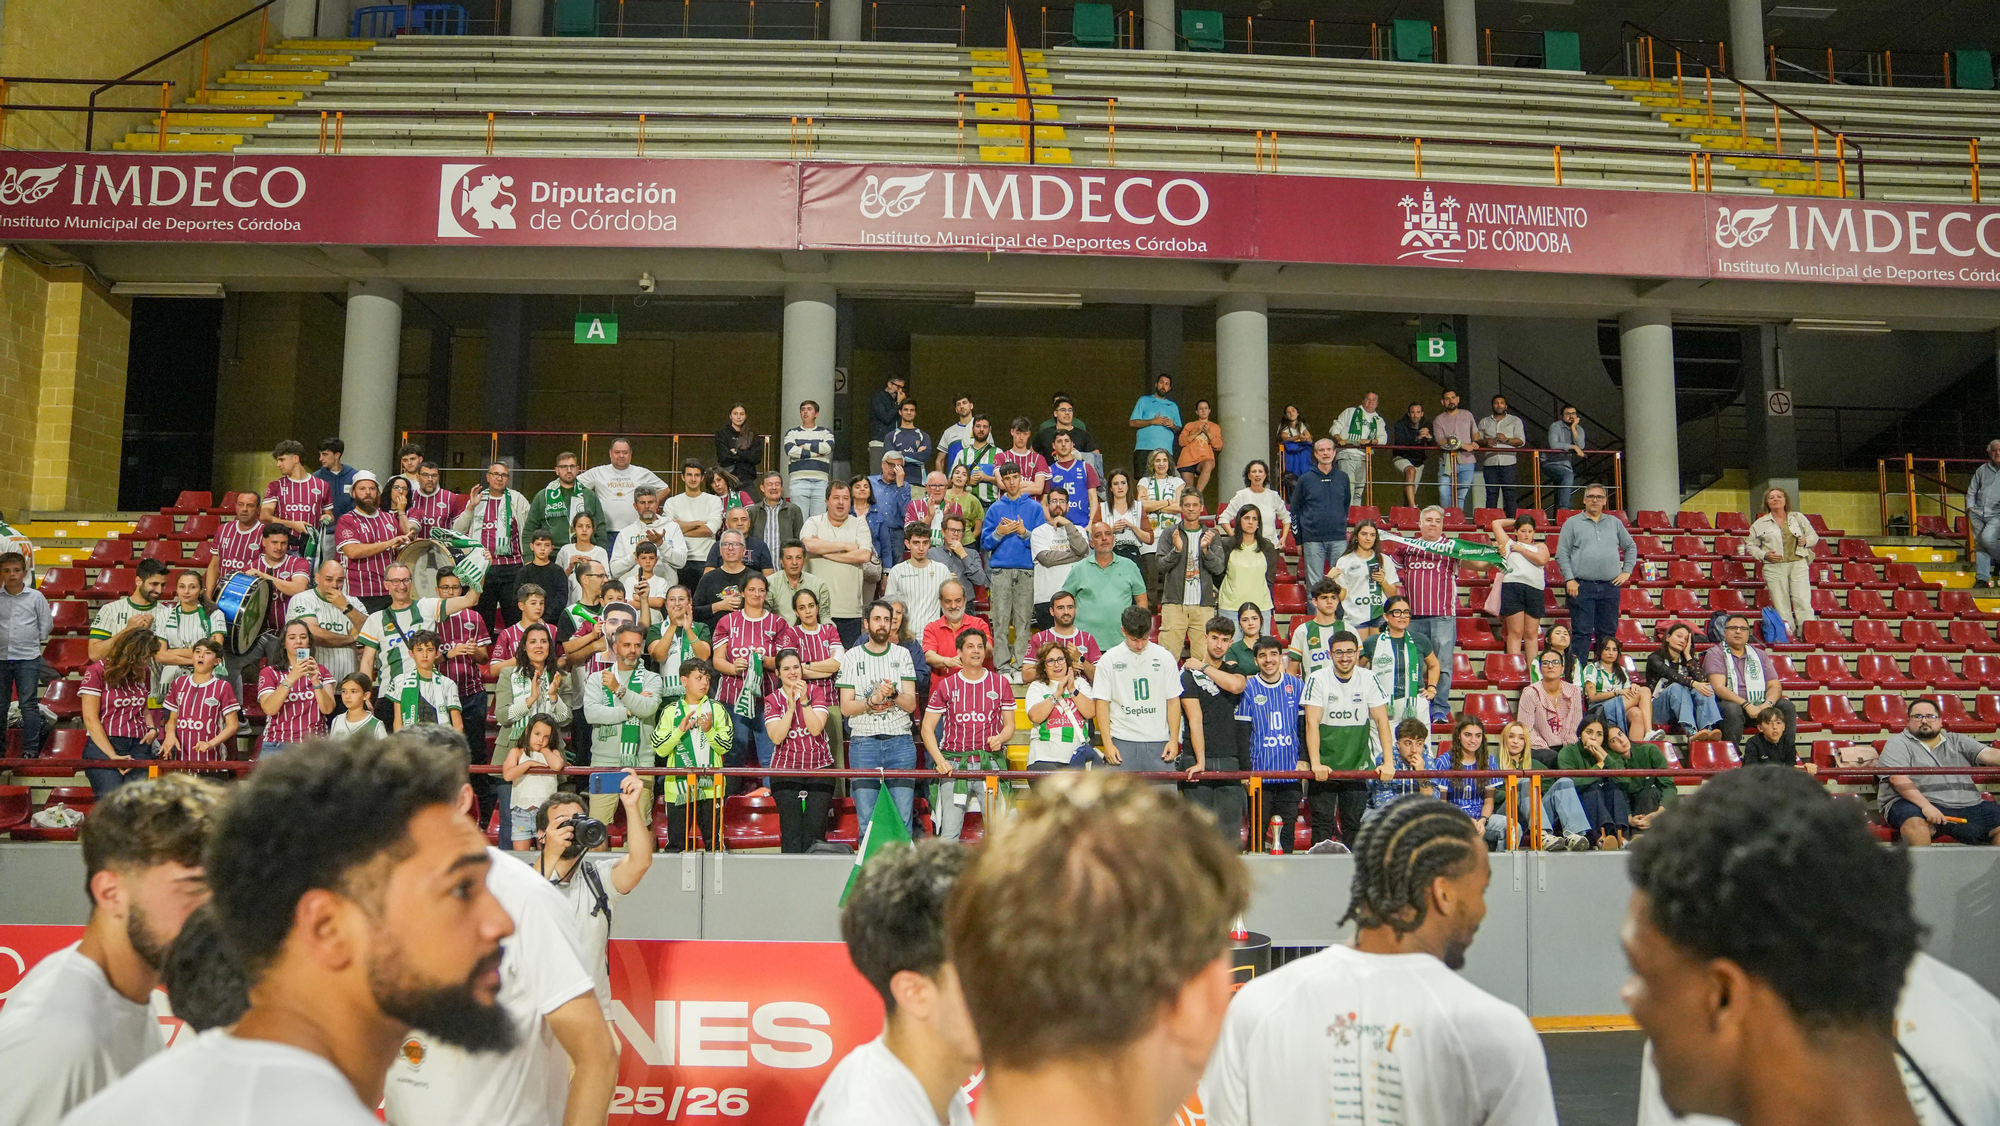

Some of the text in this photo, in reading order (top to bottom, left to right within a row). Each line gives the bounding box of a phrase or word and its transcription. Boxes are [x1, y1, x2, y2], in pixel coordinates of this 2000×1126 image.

[71, 164, 307, 209] IMDECO
[530, 181, 677, 205] Diputación
[942, 172, 1209, 226] IMDECO
[64, 215, 138, 233] Municipal
[142, 217, 161, 230] de
[166, 218, 234, 233] Deportes
[238, 216, 302, 232] Córdoba
[530, 206, 677, 231] de Córdoba
[1466, 202, 1588, 228] AYUNTAMIENTO
[861, 230, 1208, 253] Instituto Municipal de Deportes Córdoba
[1467, 227, 1572, 254] DE CÓRDOBA
[1718, 258, 1780, 274] Instituto
[1784, 261, 1859, 279] Municipal
[1862, 264, 1882, 278] de
[1886, 265, 1955, 282] Deportes
[586, 319, 606, 339] A
[1428, 337, 1445, 357] B
[1133, 678, 1150, 701] 10
